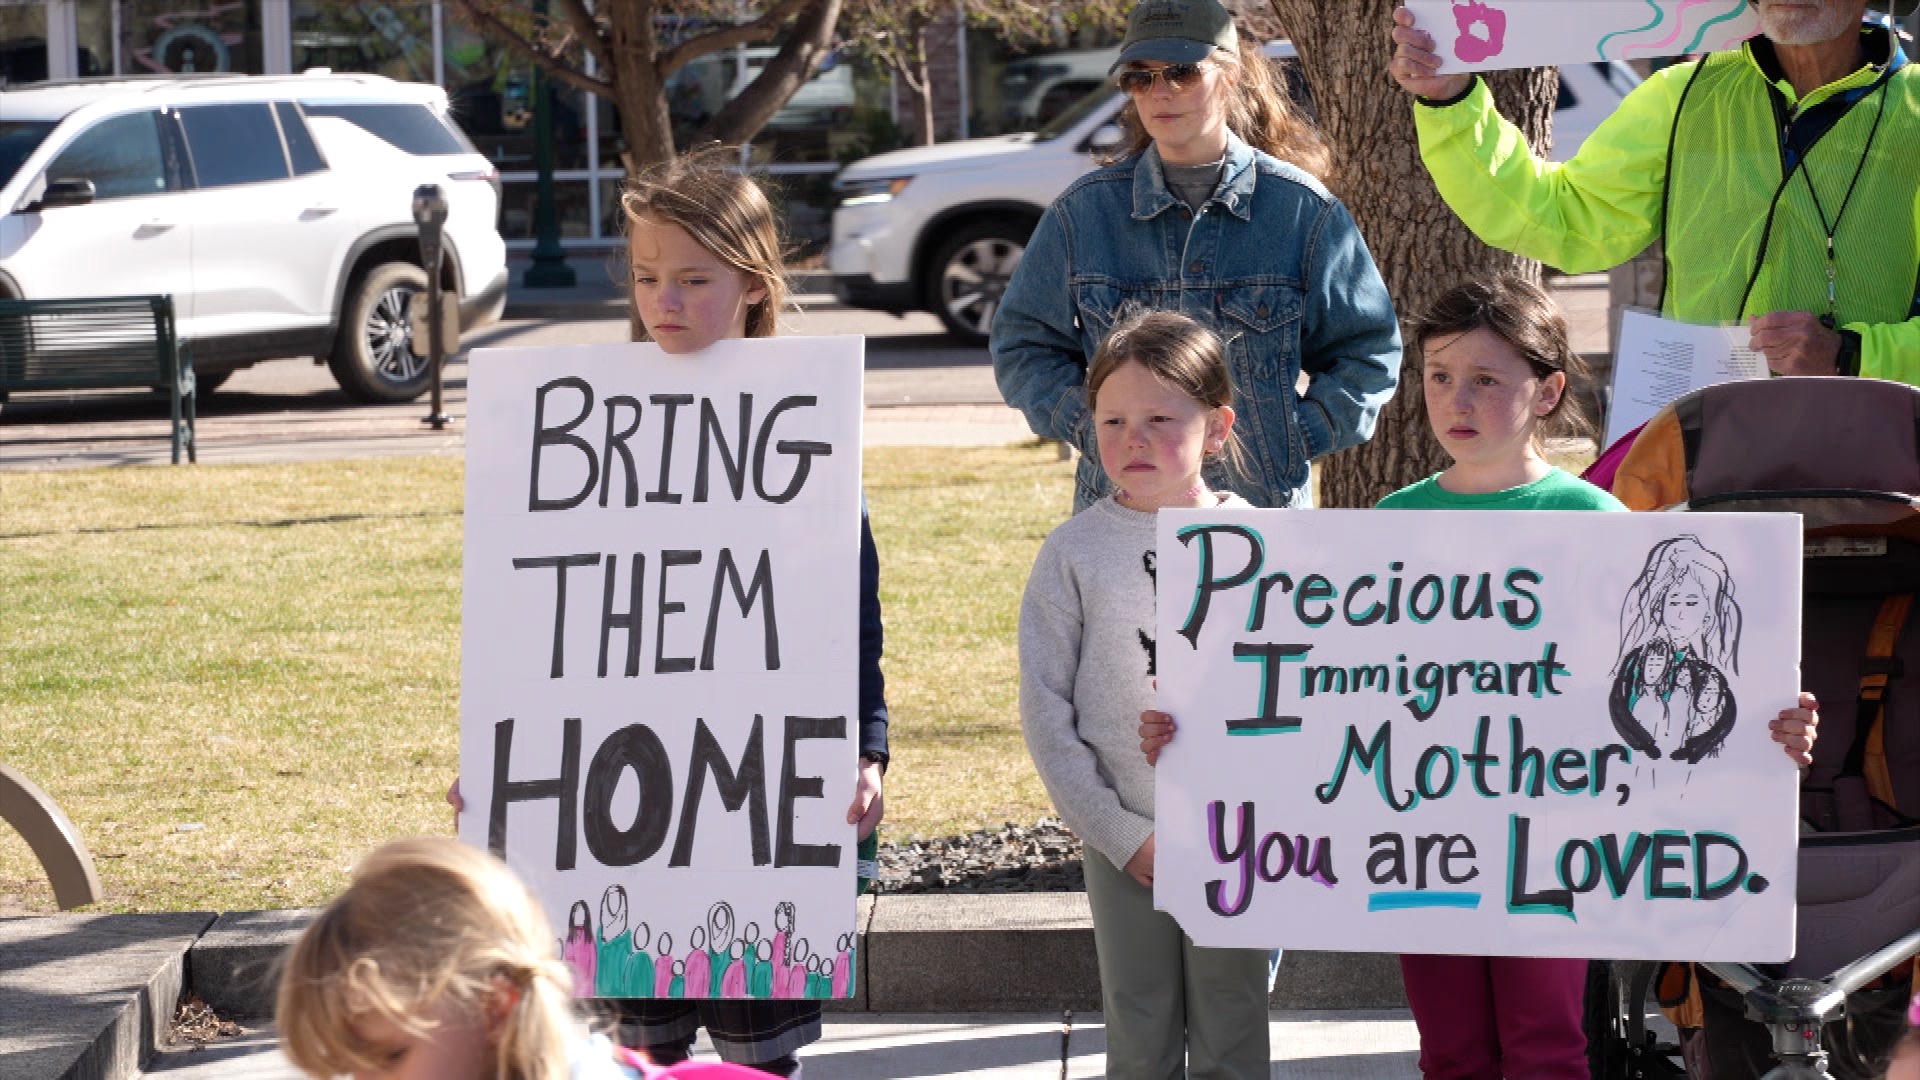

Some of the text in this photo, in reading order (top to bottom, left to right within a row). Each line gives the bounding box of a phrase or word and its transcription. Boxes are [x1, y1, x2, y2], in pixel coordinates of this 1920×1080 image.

[529, 376, 832, 512] BRING
[512, 547, 780, 678] THEM
[1176, 524, 1543, 650] Precious
[1226, 641, 1571, 736] Immigrant
[488, 714, 847, 870] HOME
[1314, 715, 1631, 812] Mother,
[1366, 832, 1479, 889] are
[1506, 812, 1769, 923] LOVED.
